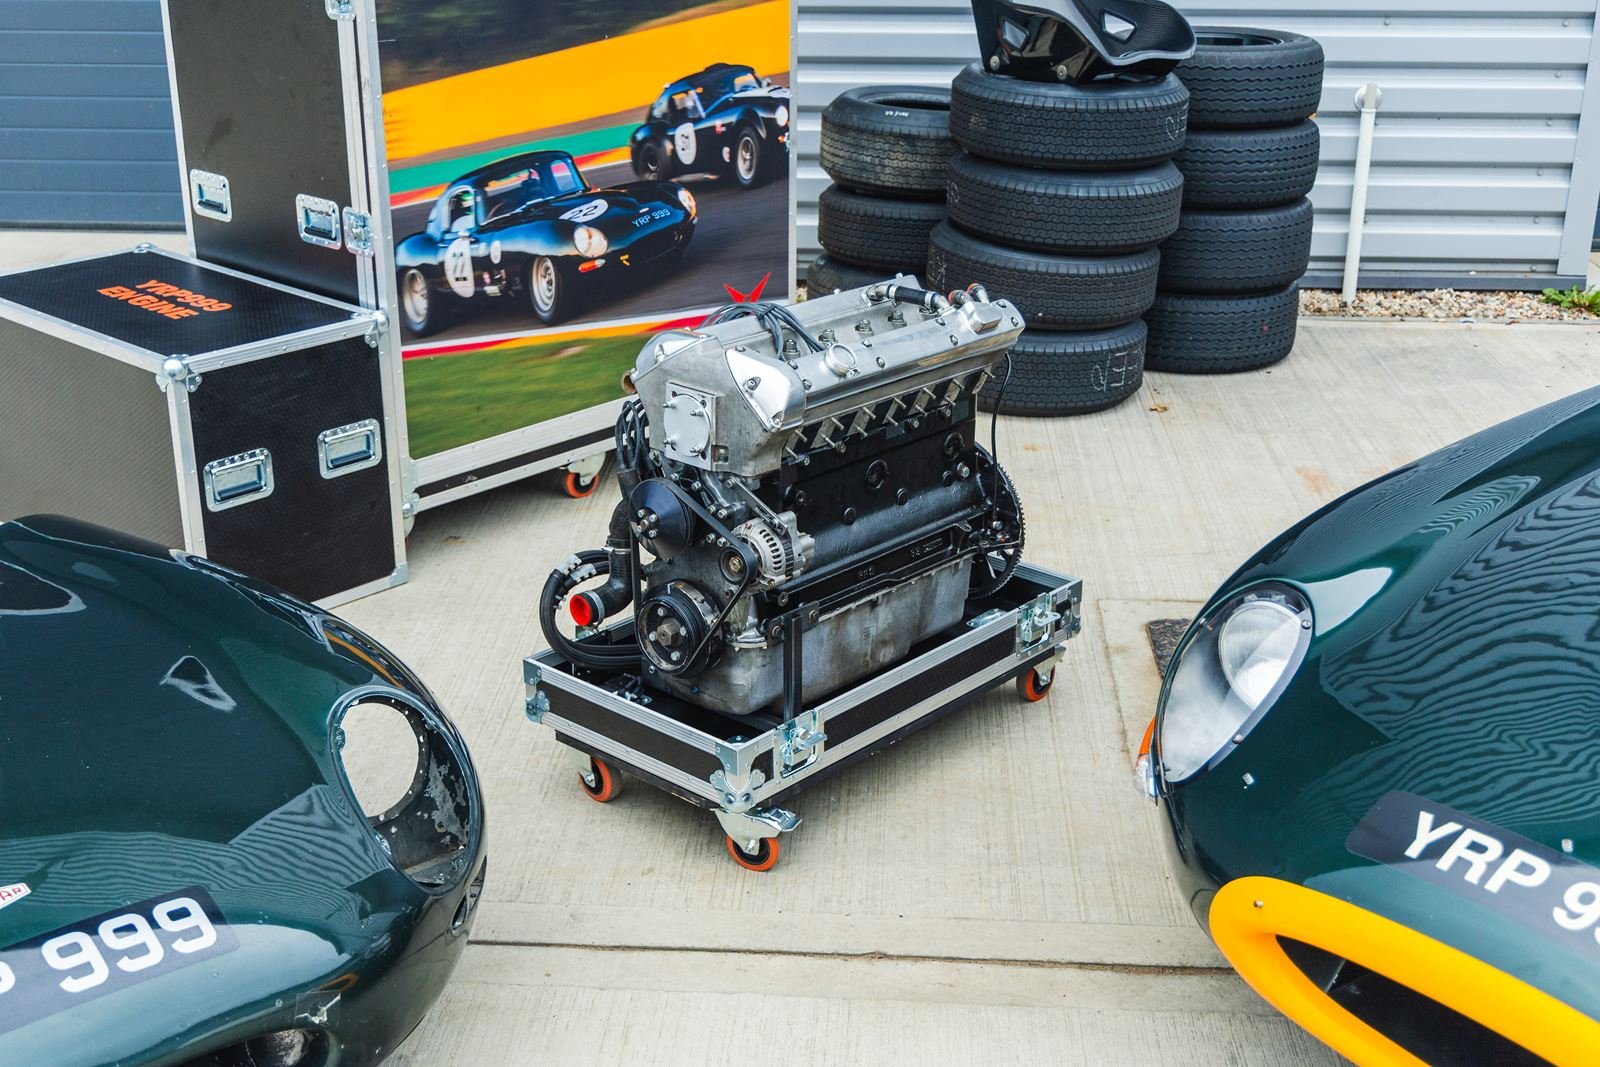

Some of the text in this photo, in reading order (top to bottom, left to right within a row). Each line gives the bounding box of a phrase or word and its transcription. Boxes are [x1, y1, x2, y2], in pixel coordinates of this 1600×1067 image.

[568, 205, 598, 220] 22
[632, 209, 670, 227] YRP 999
[97, 285, 199, 320] ENGINE
[136, 279, 232, 312] YRP999
[1404, 811, 1600, 946] YRP 9
[41, 897, 217, 993] 999
